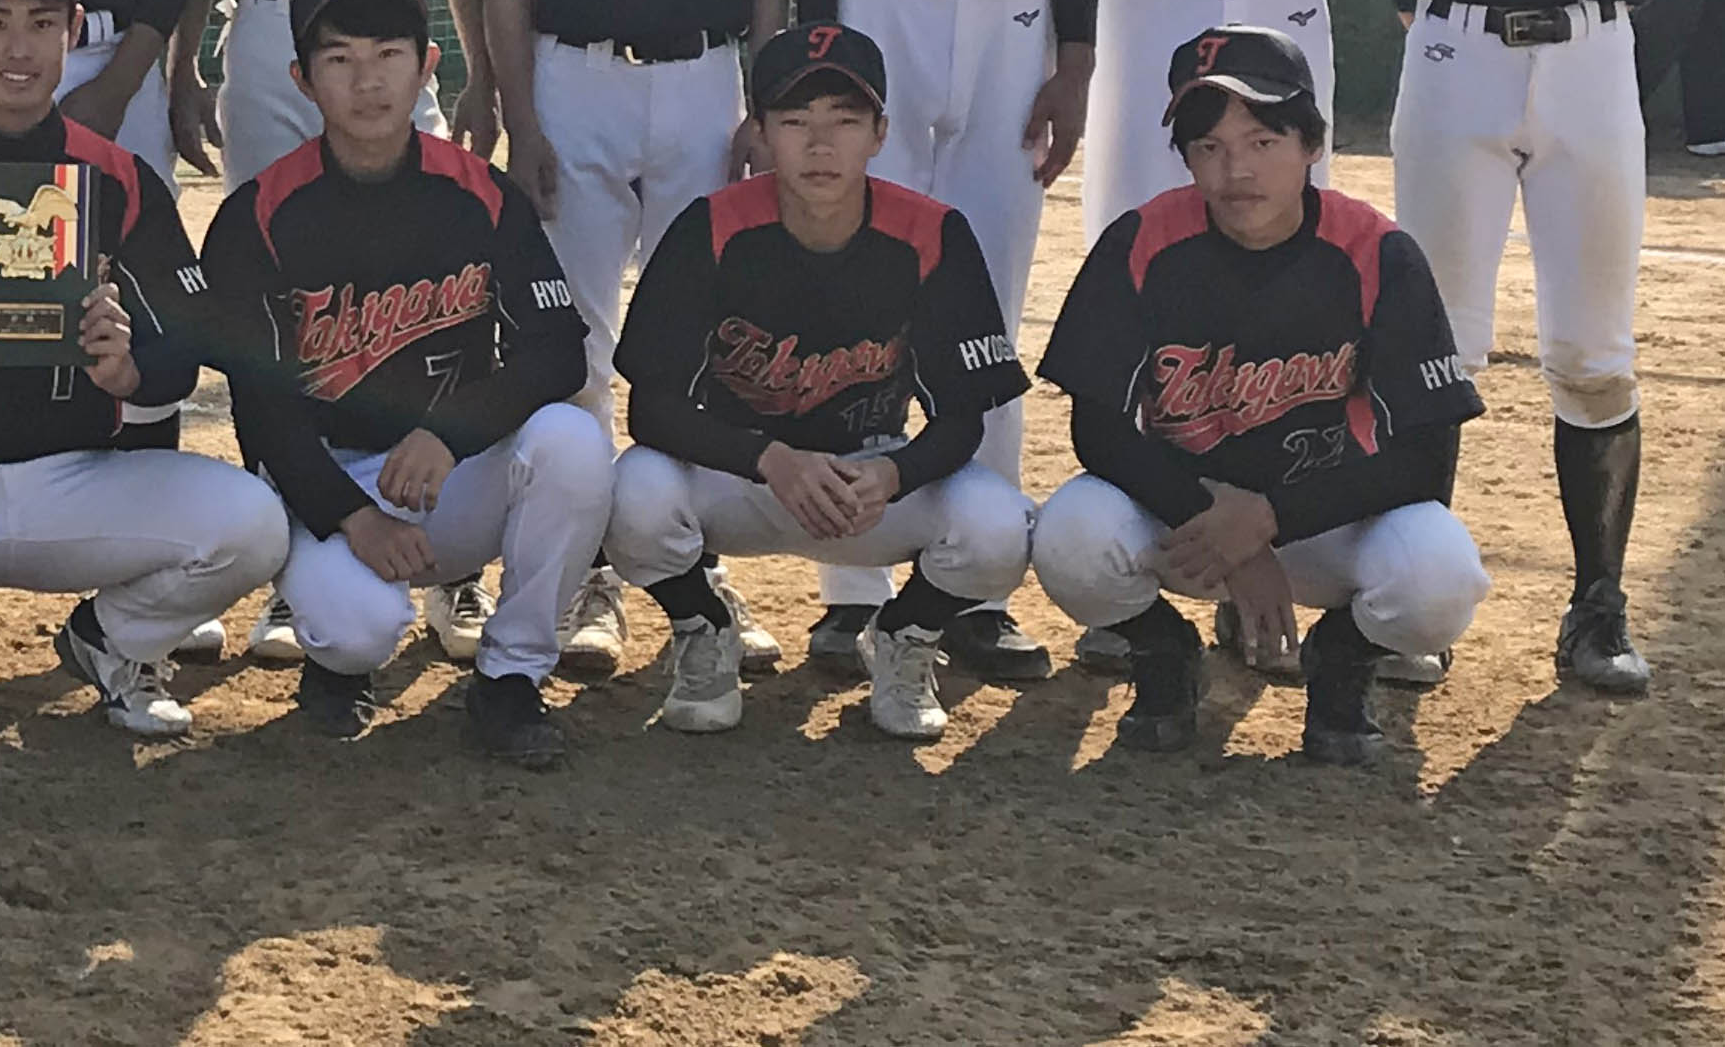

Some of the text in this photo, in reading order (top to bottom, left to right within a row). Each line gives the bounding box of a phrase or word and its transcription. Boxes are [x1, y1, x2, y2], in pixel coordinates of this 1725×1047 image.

[807, 26, 844, 60] T
[1194, 37, 1230, 73] T
[293, 262, 493, 363] Takigawa
[424, 349, 463, 412] 7
